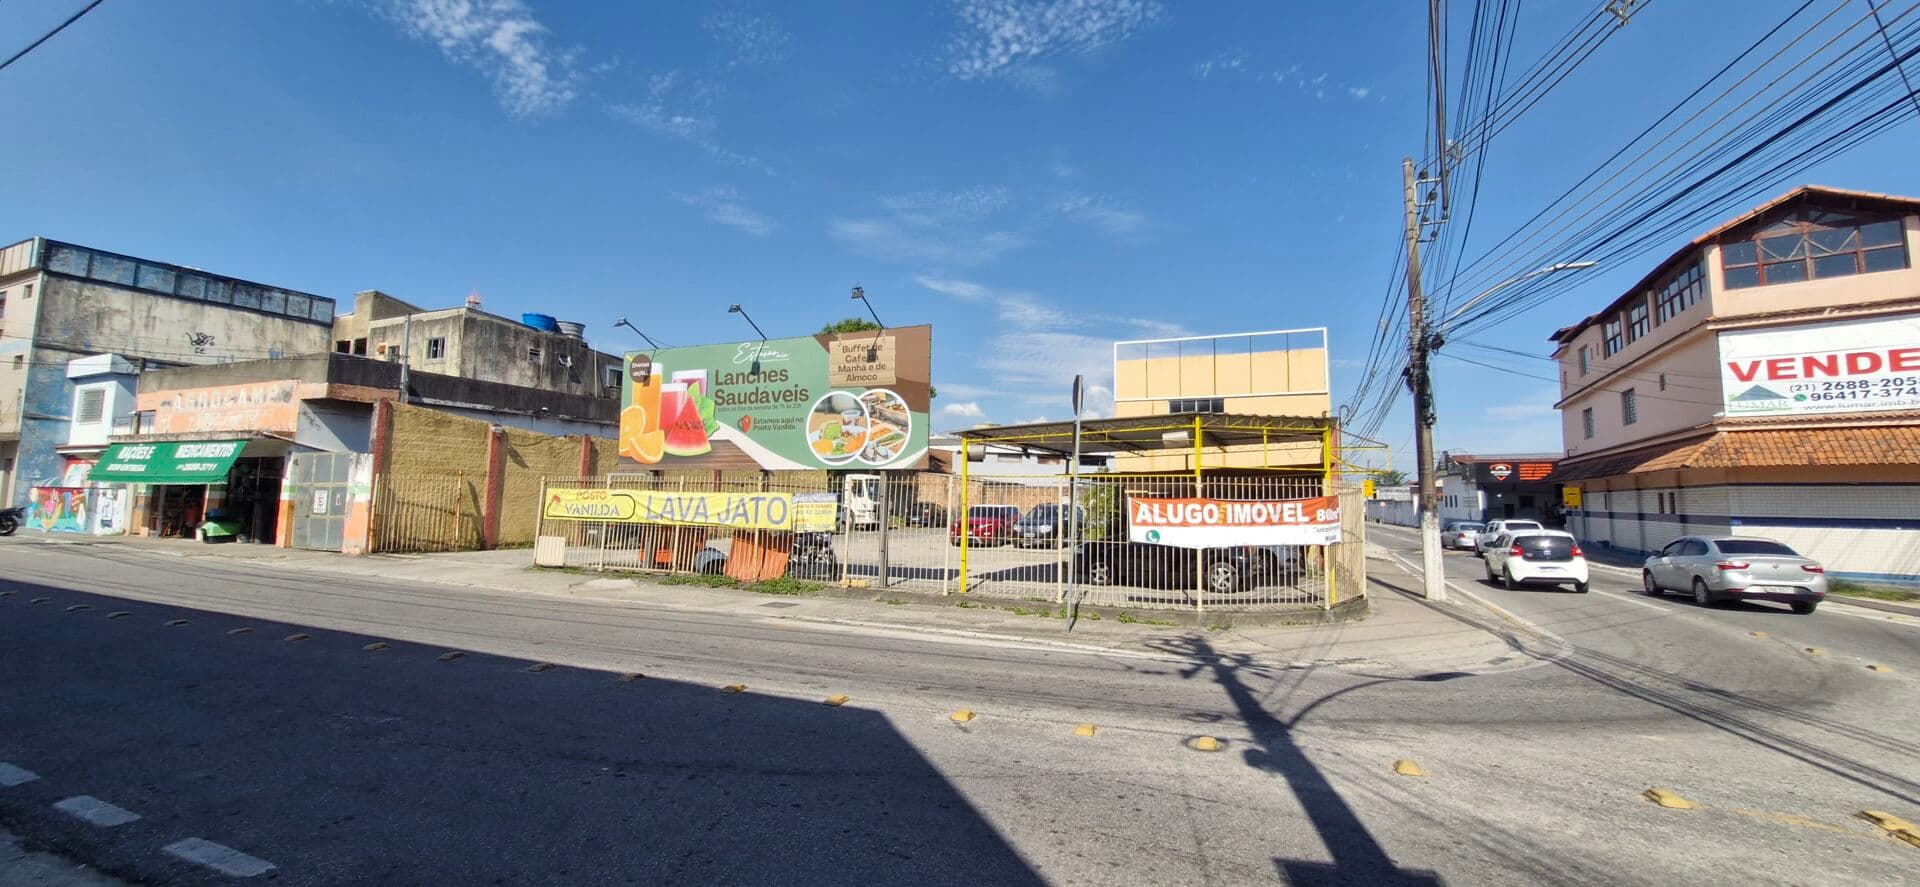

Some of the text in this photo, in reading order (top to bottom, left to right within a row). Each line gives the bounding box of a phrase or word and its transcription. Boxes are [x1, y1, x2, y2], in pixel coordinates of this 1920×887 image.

[842, 344, 870, 354] Buffet
[876, 363, 887, 371] de
[1727, 348, 1920, 382] VENDE
[714, 368, 789, 386] Lanches
[1789, 377, 1920, 393] (21) 2688-205
[714, 384, 809, 406] Saudáveis
[753, 417, 780, 425] Estamos
[174, 443, 237, 459] MEDICAMENTOS
[576, 491, 608, 501] POSTO
[565, 503, 620, 516] VANILDA
[646, 494, 788, 525] LAVA JATO
[1136, 503, 1219, 525] ALUGO
